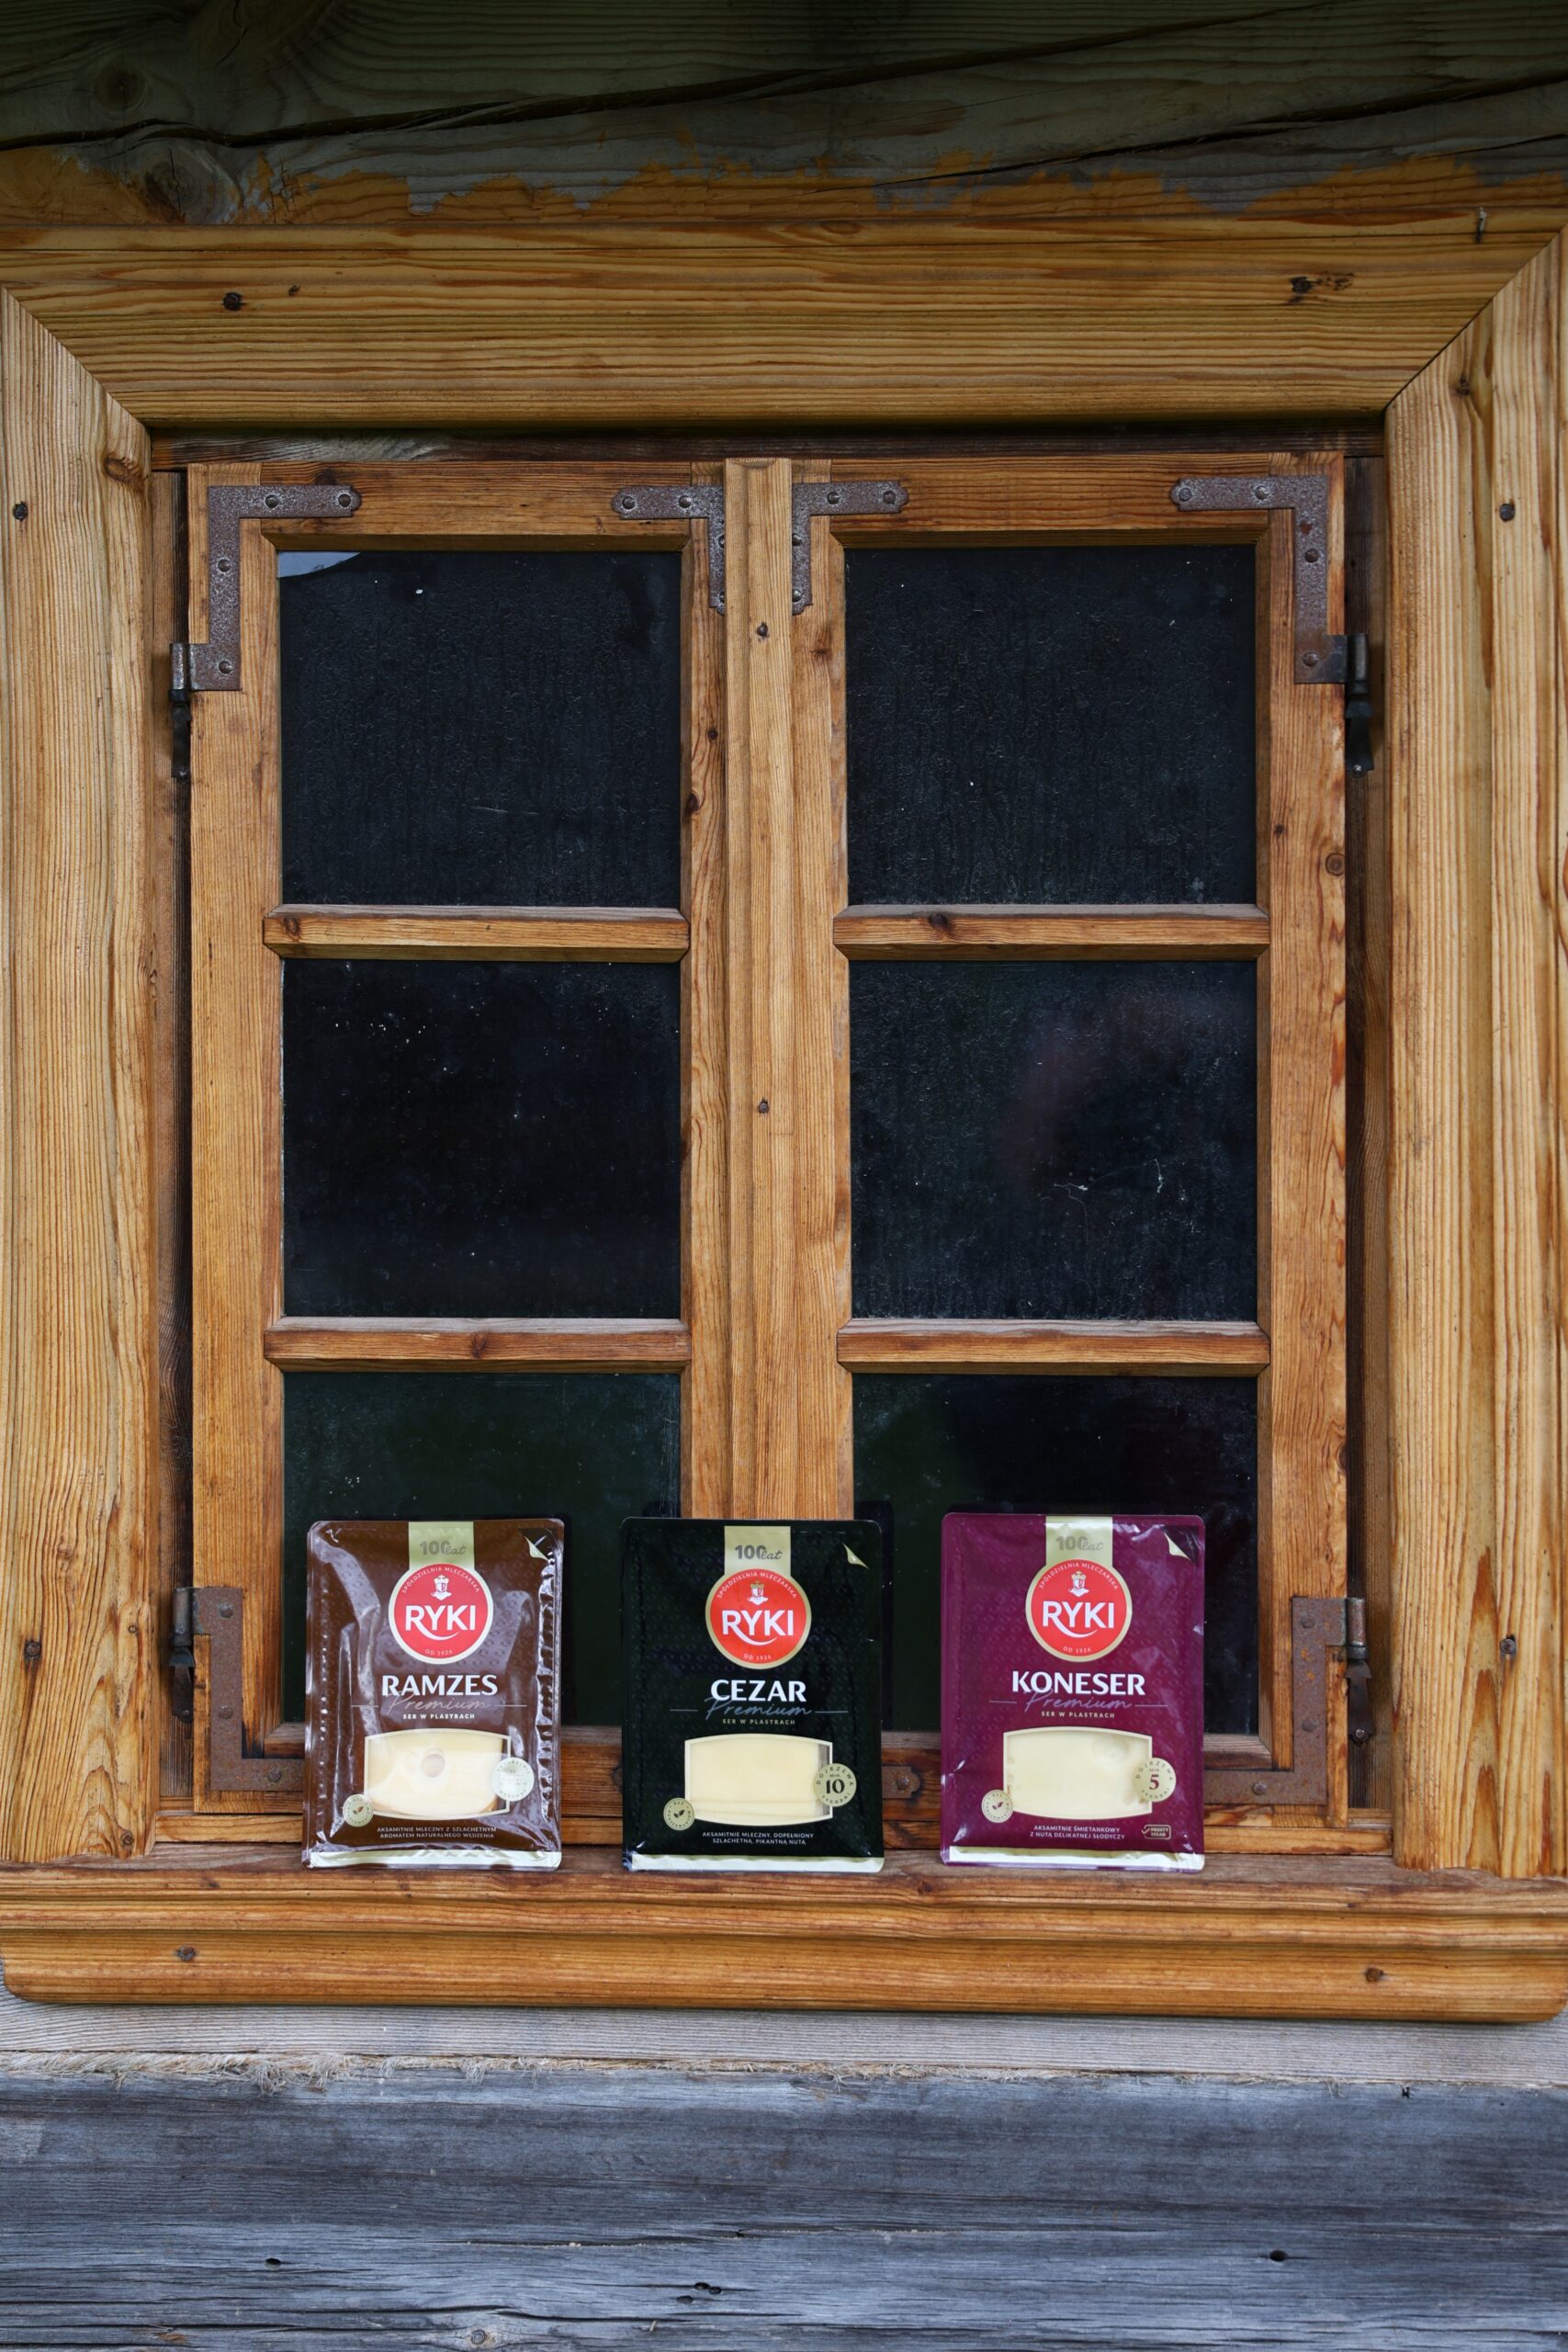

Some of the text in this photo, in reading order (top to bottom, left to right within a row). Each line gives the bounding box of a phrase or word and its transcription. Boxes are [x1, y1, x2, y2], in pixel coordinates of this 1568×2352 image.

[405, 1605, 476, 1641] RYKI
[722, 1610, 794, 1645] RYKI
[1043, 1600, 1114, 1638] RYKI
[382, 1674, 498, 1696] RAMZES
[711, 1679, 807, 1702] CEZAR
[1012, 1670, 1145, 1696] KONESER
[386, 1690, 491, 1716] Premium
[704, 1695, 812, 1720] Premium
[1023, 1689, 1132, 1713] Premium
[827, 1779, 845, 1793] 10
[1149, 1774, 1159, 1790] 5
